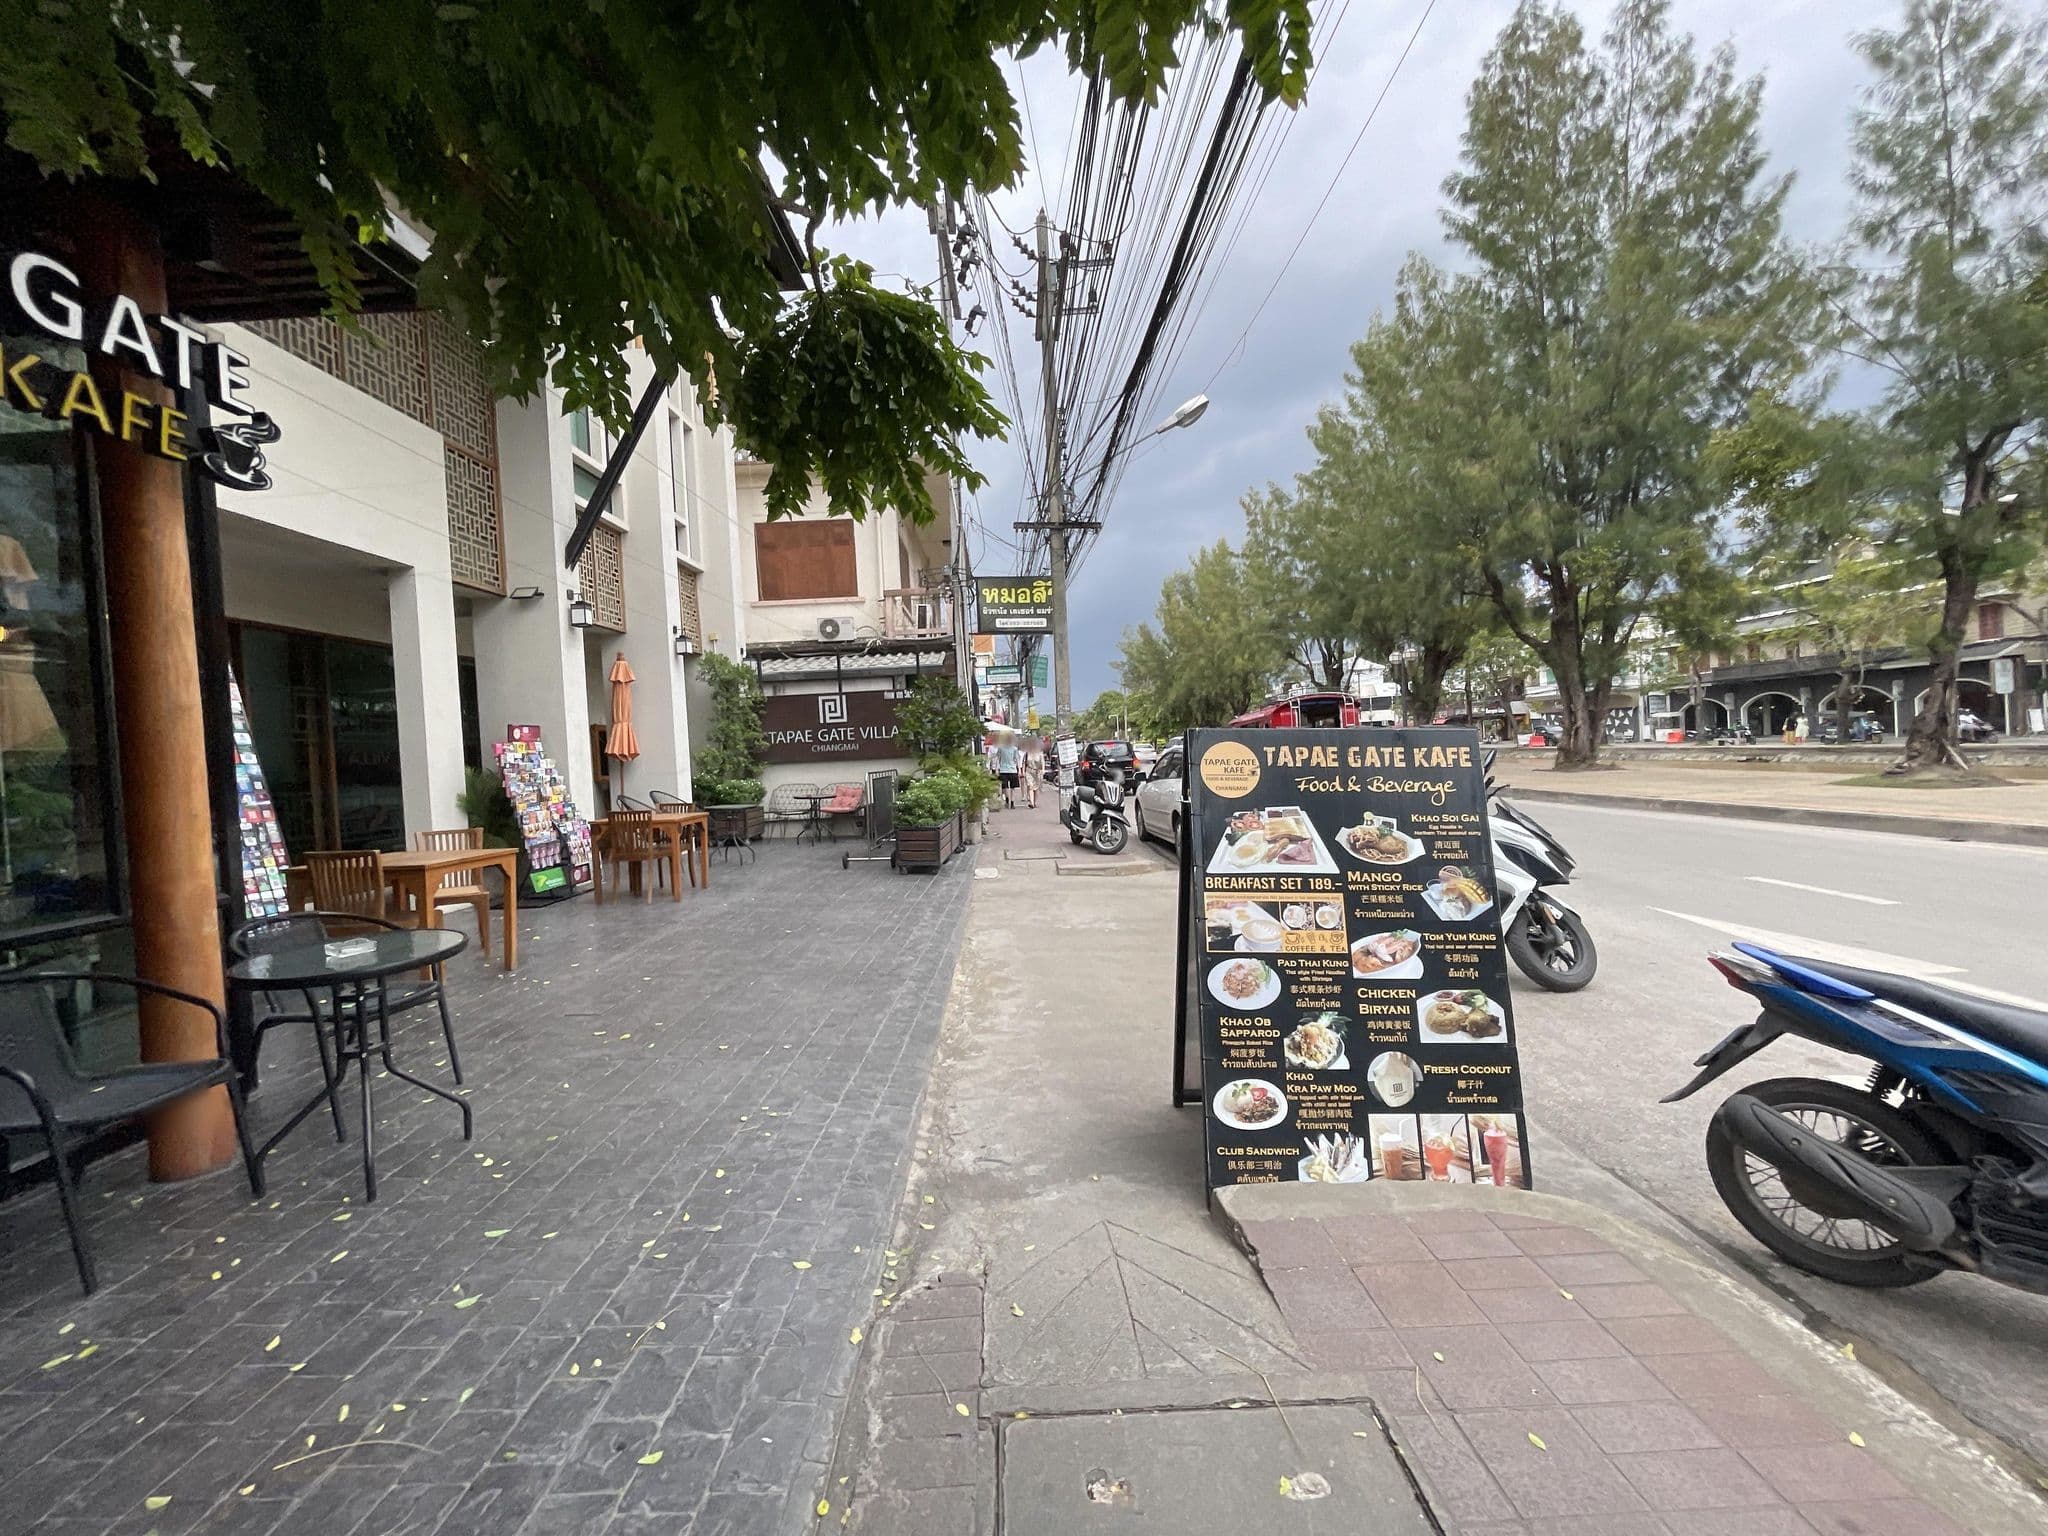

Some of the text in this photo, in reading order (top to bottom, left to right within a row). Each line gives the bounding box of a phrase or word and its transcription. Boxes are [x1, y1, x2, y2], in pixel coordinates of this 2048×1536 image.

[10, 252, 255, 414] GATE
[0, 343, 188, 461] KAFE
[768, 725, 899, 744] TAPAE GATE VILLA
[811, 744, 859, 752] CHIANGMAI
[1263, 745, 1473, 768] TAPAE GATE KAFE
[1204, 758, 1256, 766] TAPAE GATE
[1295, 776, 1456, 806] Food & Beverage
[1205, 877, 1343, 890] BREAKFAST SET 189.-
